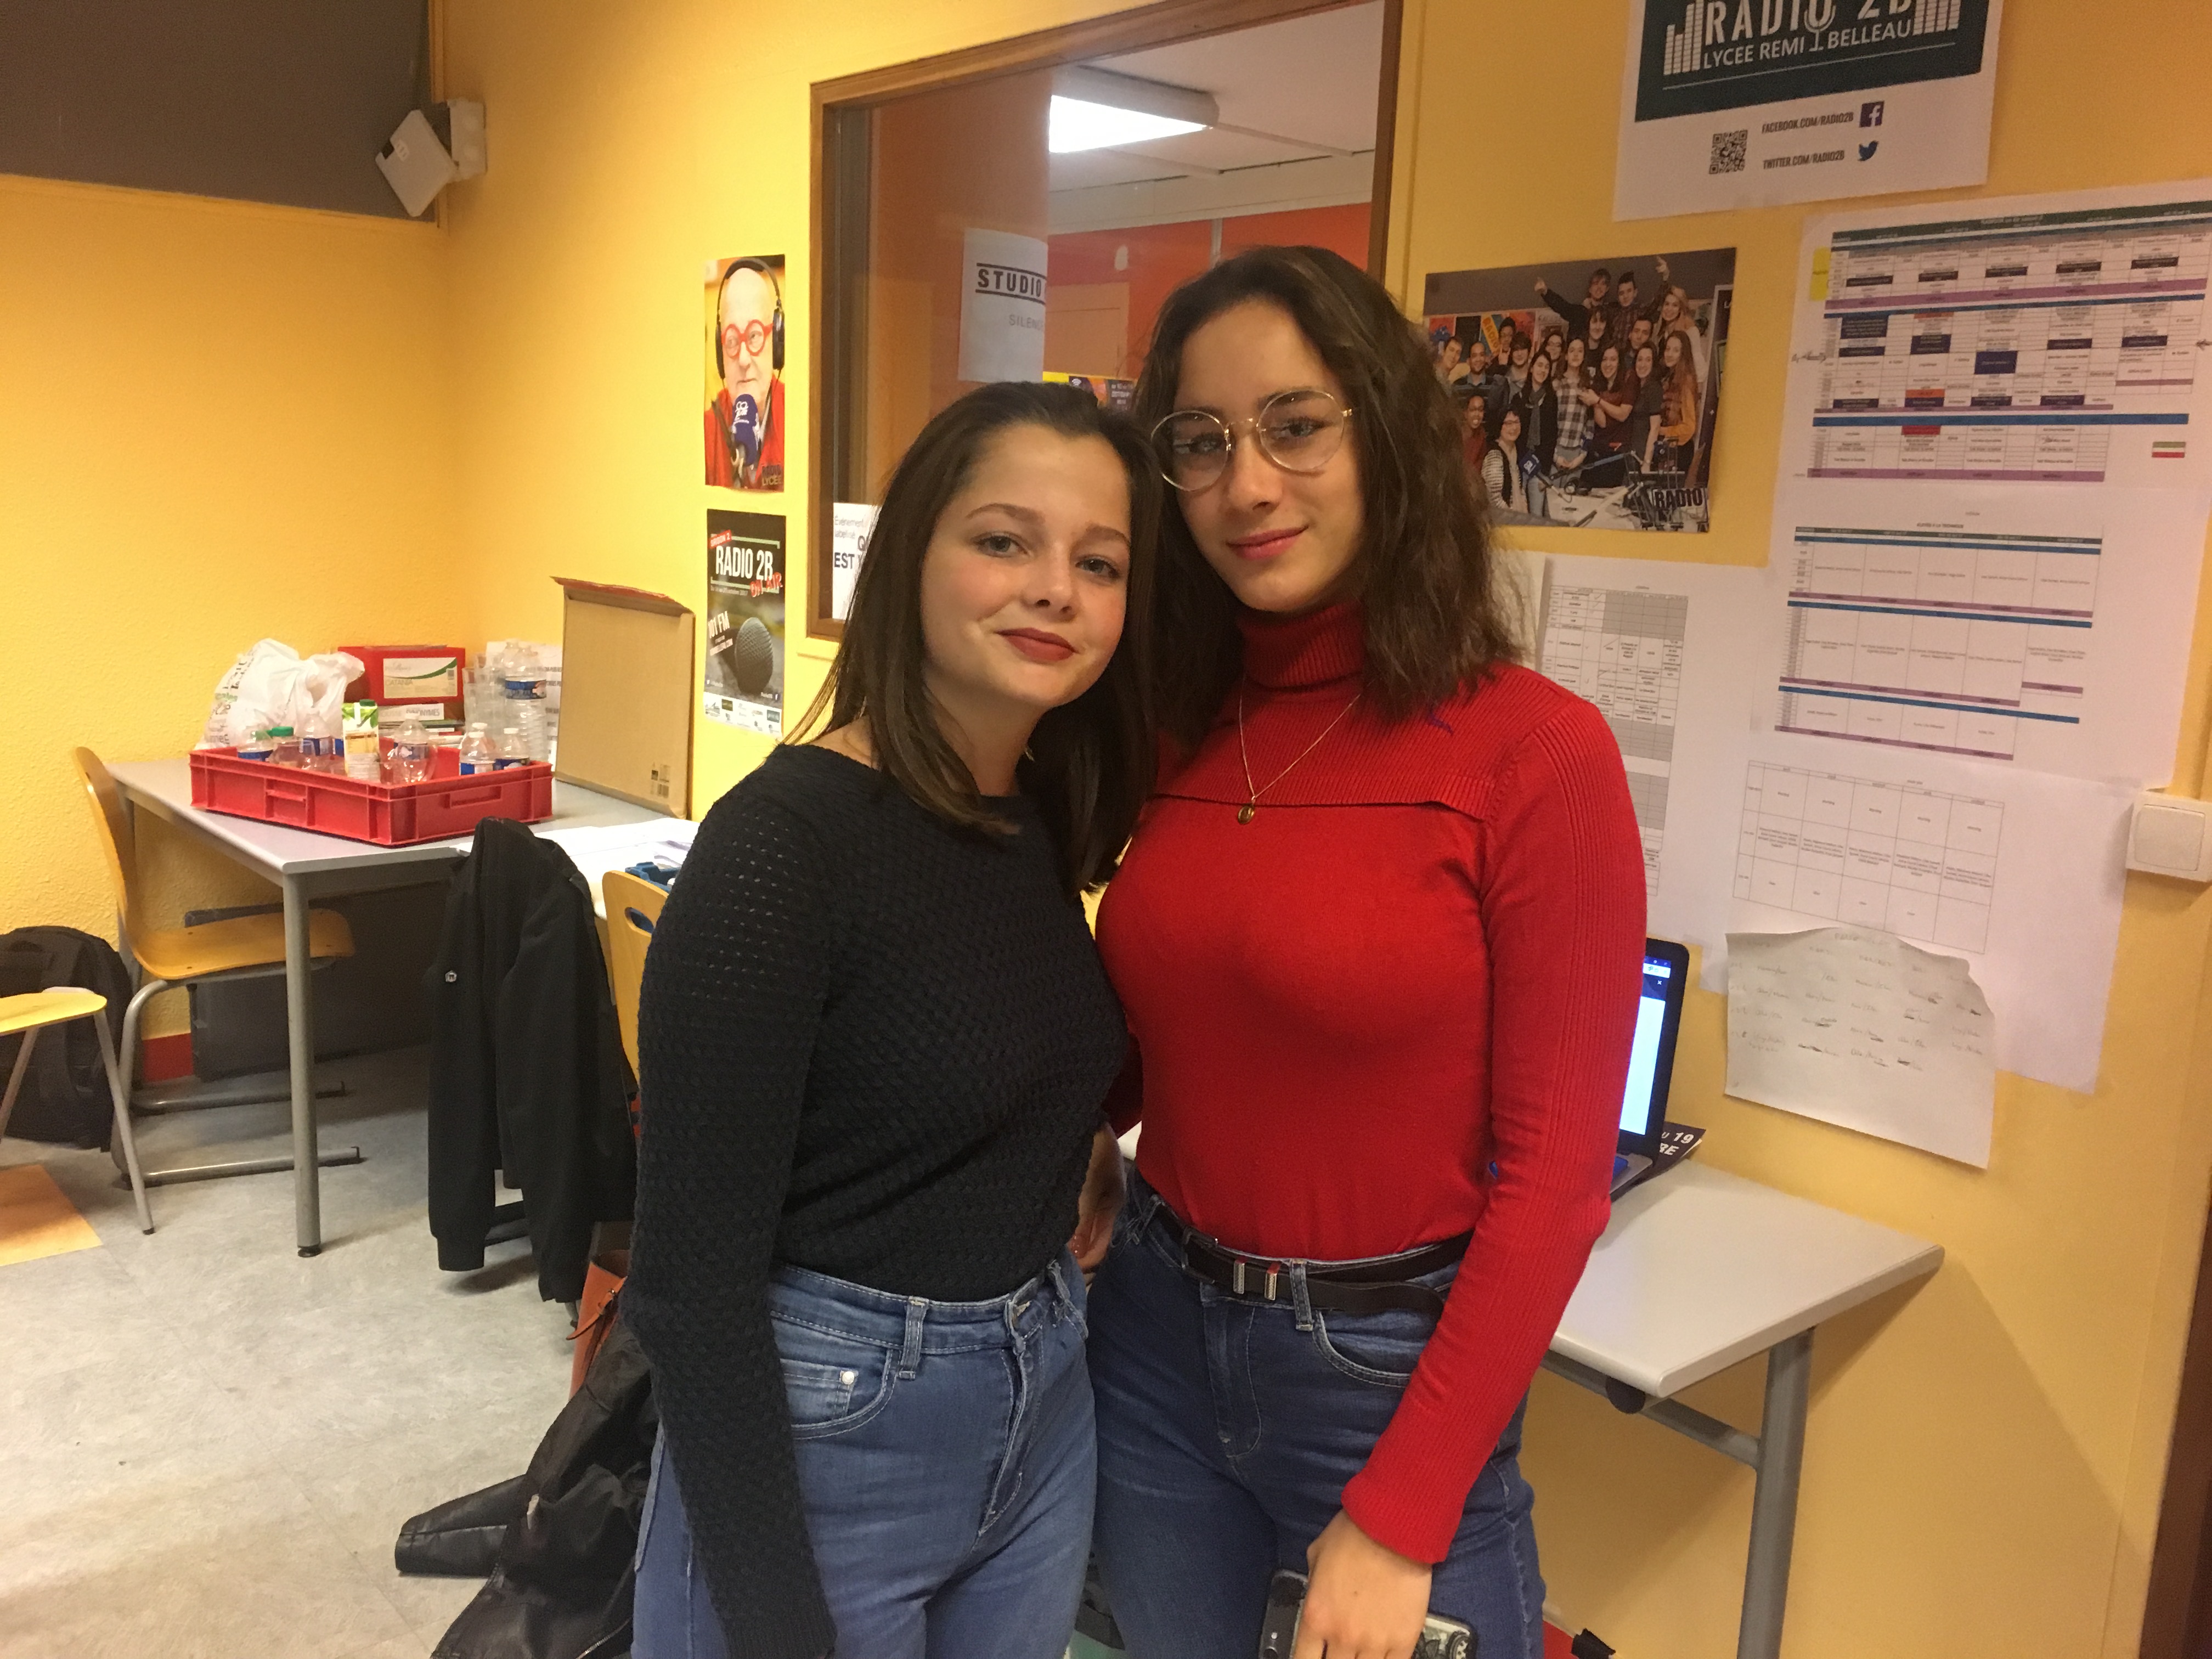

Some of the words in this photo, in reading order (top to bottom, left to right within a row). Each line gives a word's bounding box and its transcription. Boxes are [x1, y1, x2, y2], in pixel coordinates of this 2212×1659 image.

[1703, 44, 1754, 70] LYCEE
[1759, 36, 1805, 61] REMI
[1827, 19, 1911, 50] BELLEAU
[1761, 111, 1854, 134] FACEBOOK.COM/RADIO2B
[1762, 149, 1845, 170] TWITTER.COM/RADIO2B
[977, 268, 1042, 297] STUDIO
[1654, 487, 1703, 510] RADIO
[715, 545, 754, 579] RADIO
[756, 549, 774, 582] 2B
[833, 552, 855, 569] EST
[1673, 1132, 1695, 1144] 19
